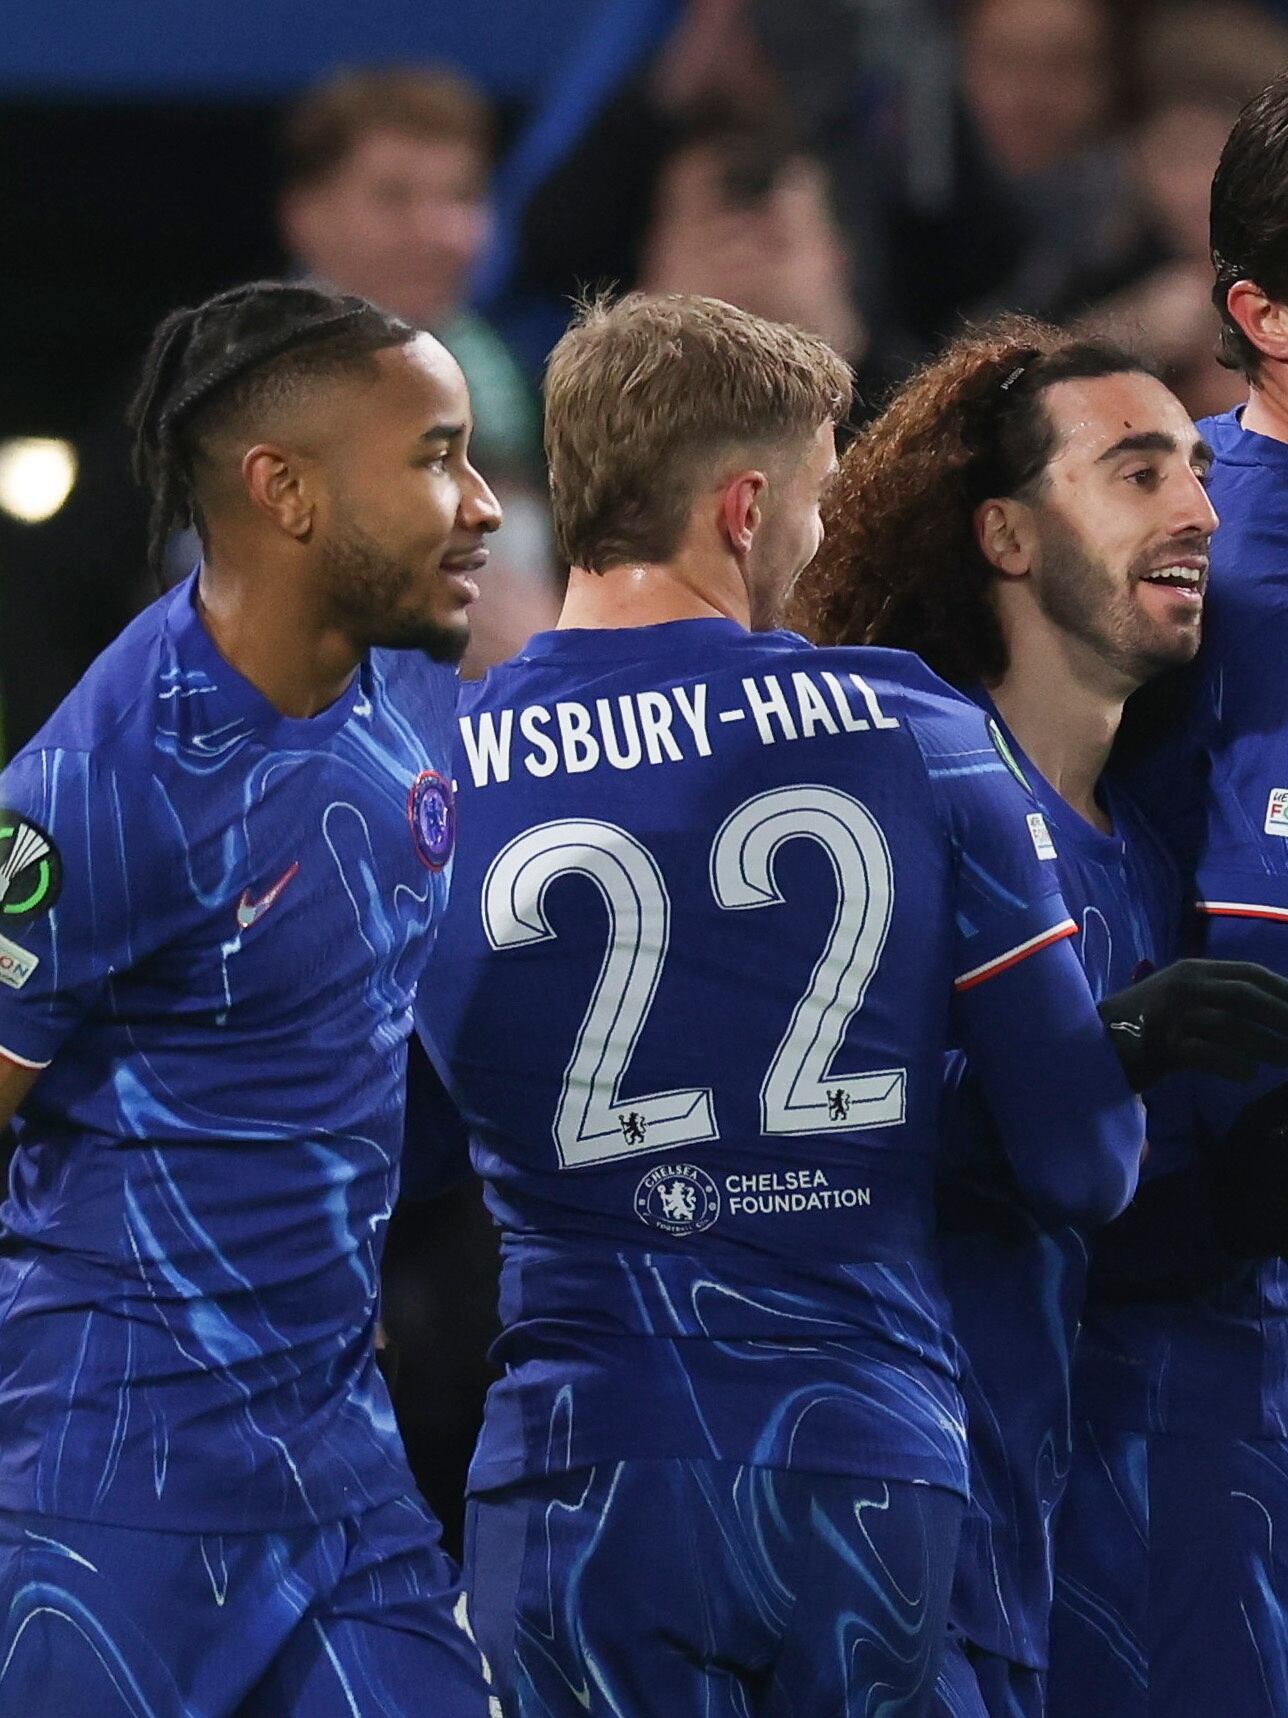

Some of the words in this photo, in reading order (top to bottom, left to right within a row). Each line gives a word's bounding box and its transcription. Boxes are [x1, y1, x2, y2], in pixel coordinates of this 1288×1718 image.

[452, 671, 900, 792] WSBURY-HALL
[481, 784, 907, 1170] 22
[645, 1165, 699, 1188] CHELSEA
[725, 1170, 829, 1193] CHELSEA
[729, 1188, 872, 1216] FOUNDATION
